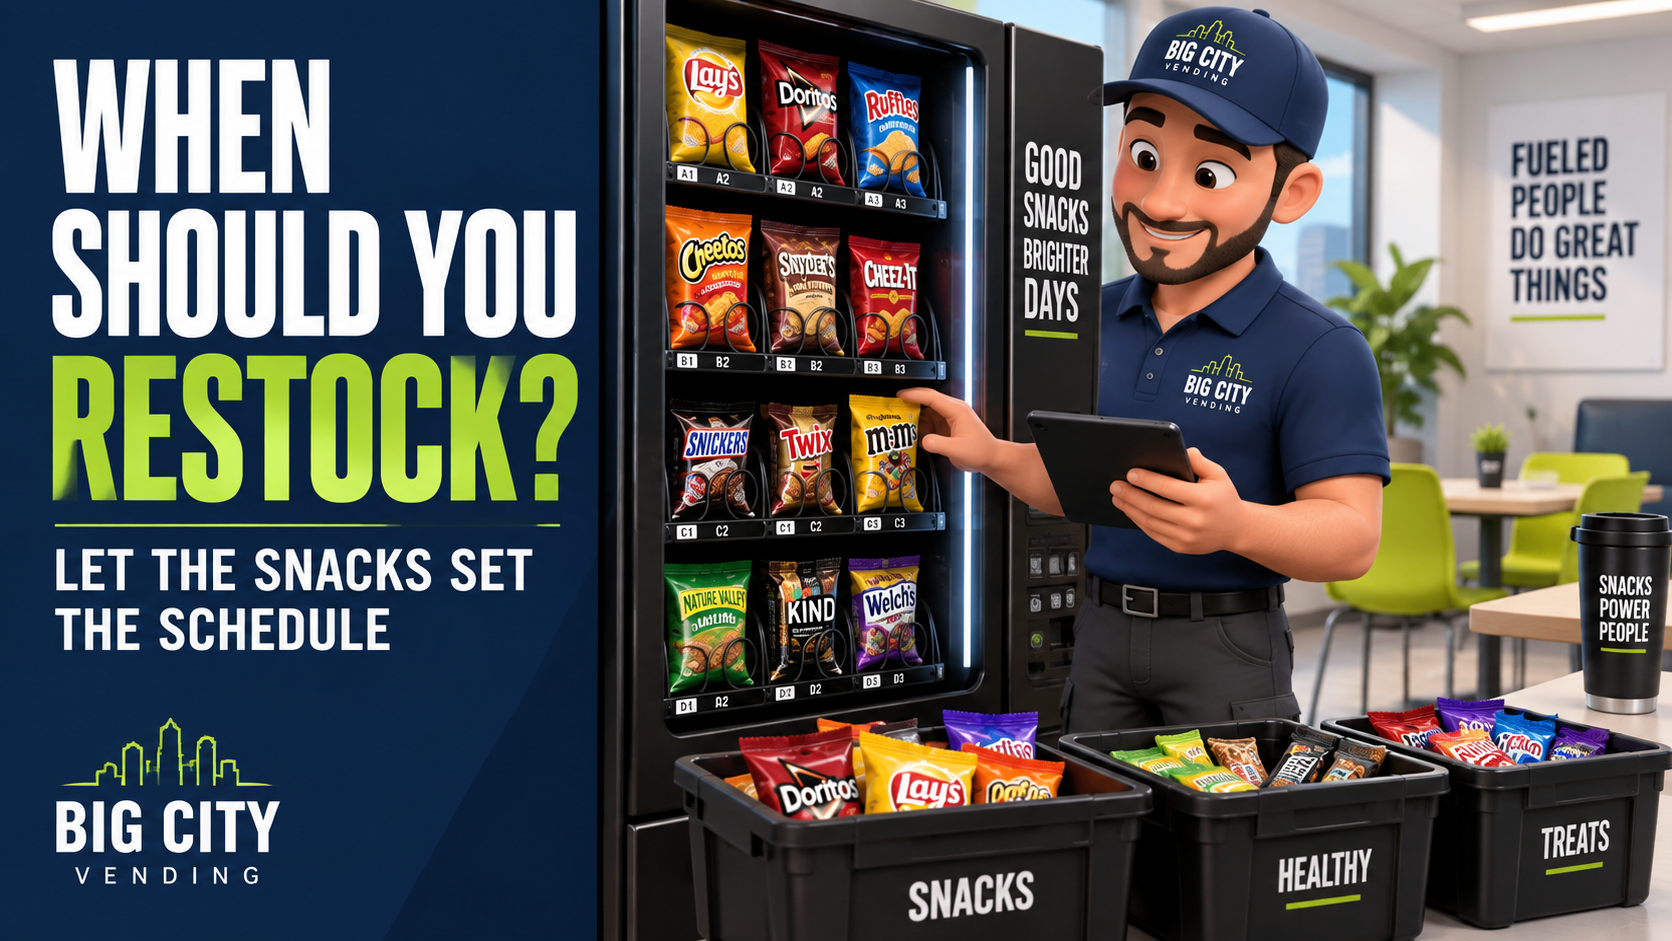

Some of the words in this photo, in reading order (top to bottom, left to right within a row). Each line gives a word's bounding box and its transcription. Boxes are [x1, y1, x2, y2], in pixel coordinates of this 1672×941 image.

[1164, 39, 1198, 63] BIG
[1198, 46, 1245, 78] CITY
[1165, 62, 1229, 86] VENDING
[778, 81, 838, 112] Doritos
[865, 90, 919, 123] Ruffles
[1024, 140, 1082, 191] GOOD
[1512, 137, 1609, 178] FUELED
[681, 168, 694, 180] A1
[716, 172, 730, 185] A2
[780, 182, 793, 193] A2
[811, 186, 823, 198] A2
[868, 193, 880, 205] A3
[895, 198, 907, 210] A3
[1023, 191, 1090, 236] SNACKS
[1512, 180, 1607, 219] PEOPLE
[1511, 226, 1544, 260] DO
[1554, 221, 1640, 259] GREAT
[681, 234, 746, 279] Cheetos
[1023, 237, 1090, 277] BRIGHTER
[864, 259, 917, 290] CHEEZ-IT
[1510, 266, 1608, 304] THINGS
[1024, 277, 1080, 323] DAYS
[681, 355, 693, 367] B1
[716, 357, 730, 368] B2
[810, 360, 822, 371] B2
[867, 363, 879, 373] B3
[895, 363, 905, 374] B3
[1183, 374, 1213, 397] BIG
[1214, 380, 1253, 405] CITY
[1185, 396, 1241, 415] VENDING
[685, 431, 749, 457] SNICKERS
[780, 424, 833, 461] Twix
[680, 527, 693, 538] C1
[715, 524, 729, 537] C2
[779, 523, 792, 533] C1
[810, 521, 822, 532] C2
[894, 517, 906, 529] C3
[1599, 574, 1653, 597] SNACKS
[683, 590, 718, 615] NATURE
[718, 589, 746, 608] VALLEY
[787, 597, 836, 625] KIND
[864, 583, 916, 618] Welch's
[1599, 597, 1651, 620] POWER
[1599, 621, 1650, 643] PEOPLE
[809, 683, 822, 695] D2
[893, 673, 904, 684] D3
[680, 700, 692, 712] D1
[779, 778, 859, 814] Doritos
[1541, 819, 1611, 860] TREATS
[1278, 848, 1373, 893] HEALTHY
[908, 870, 1035, 922] SNACKS
